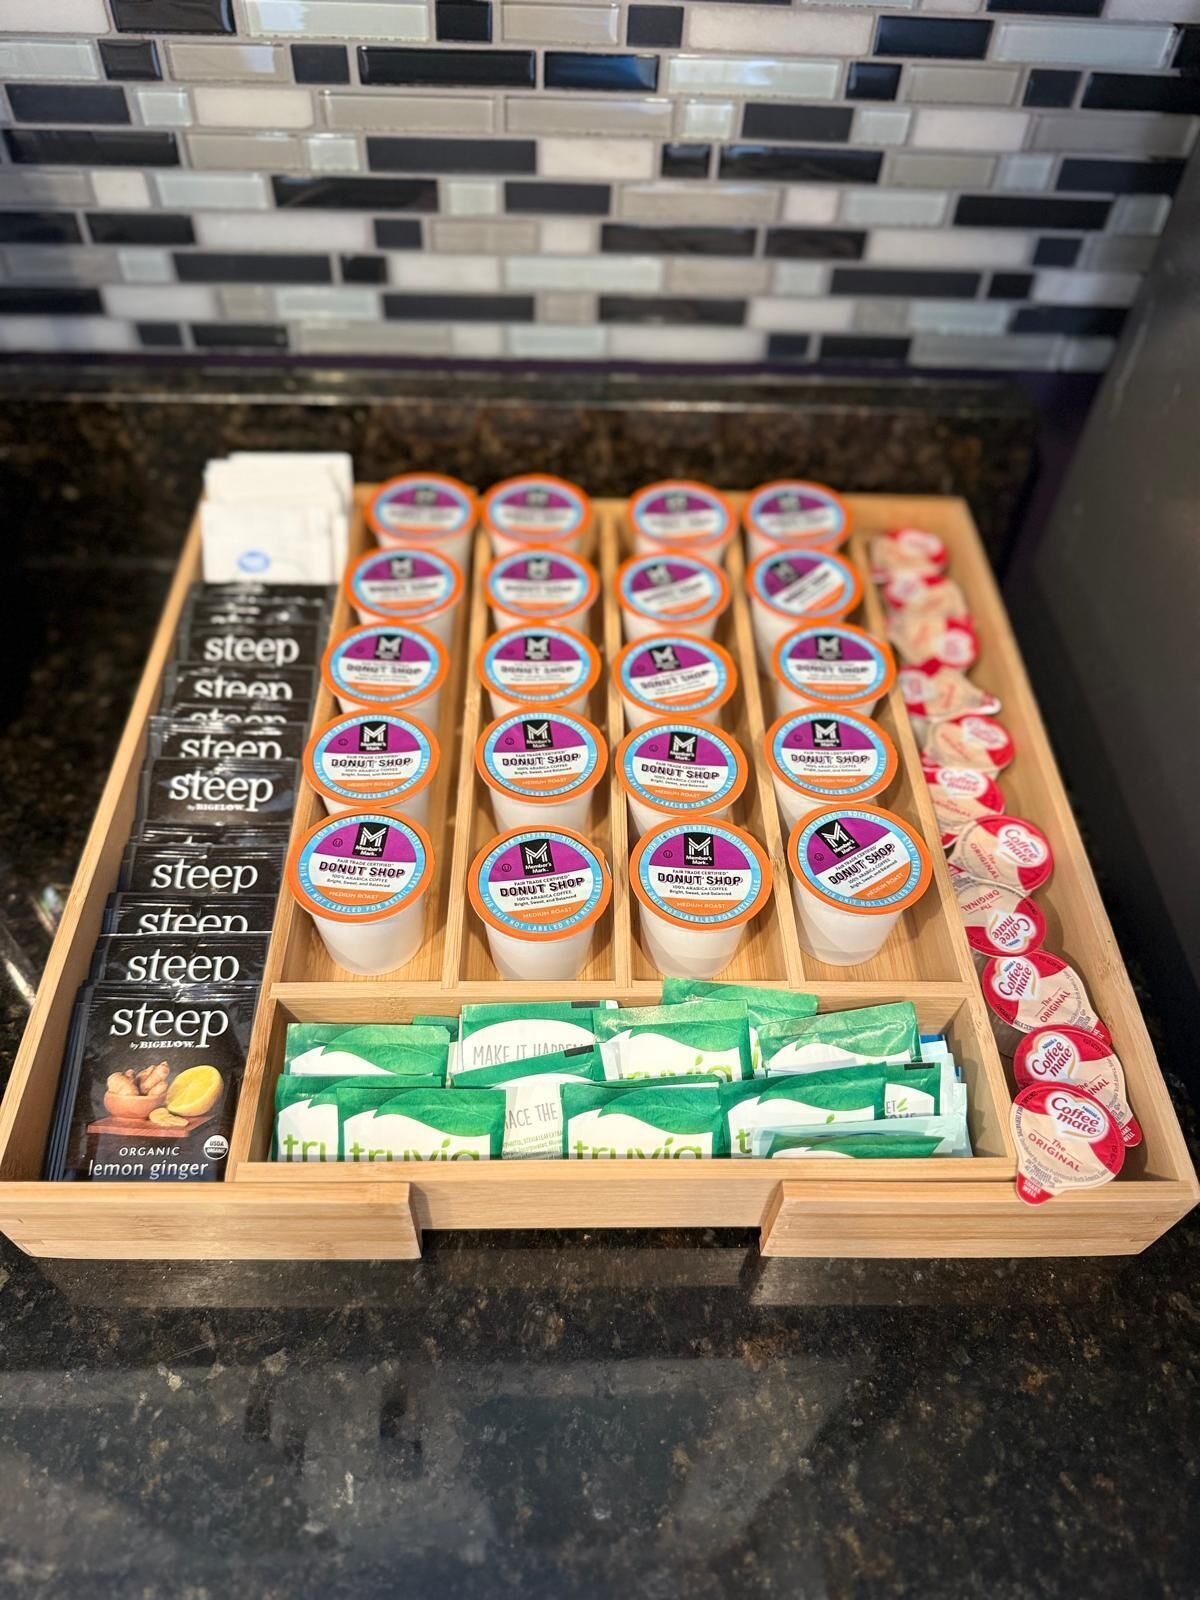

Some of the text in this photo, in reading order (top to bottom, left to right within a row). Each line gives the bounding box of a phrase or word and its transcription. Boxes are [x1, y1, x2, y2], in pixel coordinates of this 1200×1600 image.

[204, 634, 300, 667] steep
[332, 758, 413, 767] DONUT SHOP
[502, 753, 581, 766] DONUT SHOP
[791, 754, 869, 764] DONUT SHOP
[641, 764, 719, 779] DONUT SHOP
[169, 770, 273, 812] steep
[1002, 840, 1031, 863] mate
[1005, 829, 1038, 859] Coffee
[319, 862, 405, 878] DONUT SHOP
[828, 844, 895, 885] DONUT SHOP
[971, 843, 999, 879] ORIGINAL
[151, 858, 258, 894] steep
[500, 878, 584, 896] DONUT SHOP
[658, 873, 743, 886] DONUT SHOP
[961, 889, 1000, 912] ORIGINAL
[992, 916, 1015, 939] mate
[999, 918, 1030, 944] Coffee
[999, 962, 1024, 996] Coffee
[1015, 968, 1032, 996] mate
[1040, 990, 1071, 1023] ORIGINAL
[1041, 997, 1052, 1007] The
[110, 1002, 229, 1048] steep
[130, 1042, 139, 1050] by
[473, 1044, 510, 1065] MAKE
[1032, 1042, 1064, 1075] Coffee
[1050, 1048, 1072, 1077] mate
[506, 1102, 558, 1129] ACE THE
[1051, 1097, 1099, 1127] Coffee
[1056, 1113, 1096, 1134] mate
[120, 1147, 180, 1156] ORGANIC
[1028, 1132, 1080, 1172] ORIGINAL
[1052, 1138, 1066, 1152] The
[89, 1160, 208, 1179] lemon ginger
